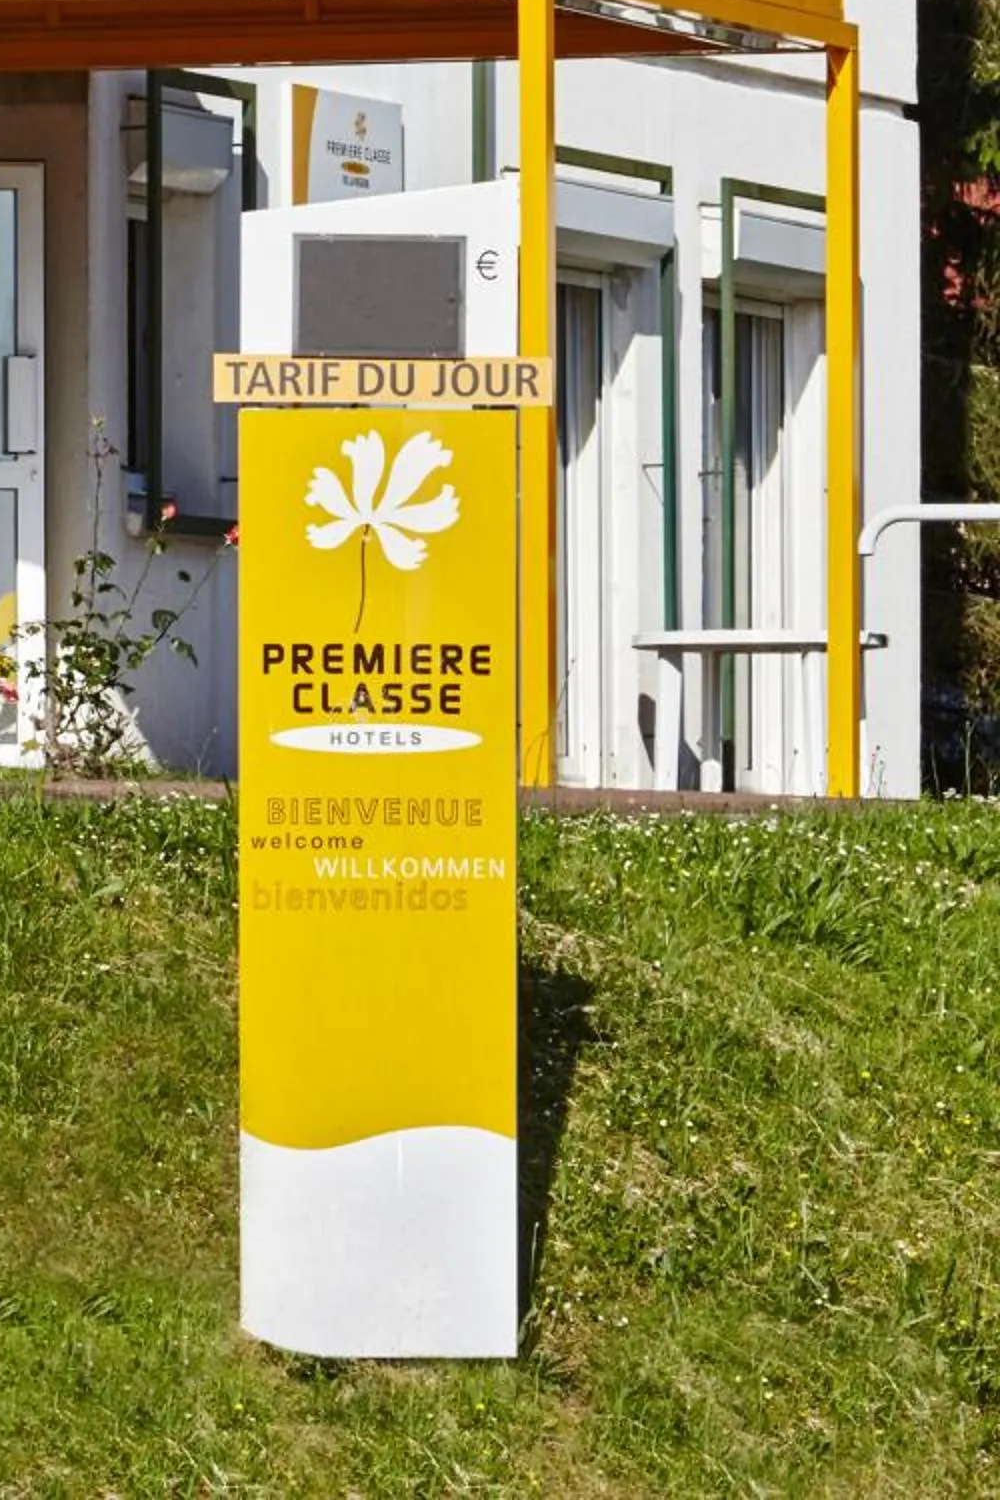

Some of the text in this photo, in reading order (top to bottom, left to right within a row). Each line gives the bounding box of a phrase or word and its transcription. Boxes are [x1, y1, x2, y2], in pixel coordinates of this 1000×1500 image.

[226, 361, 539, 398] TARIF DU JOUR
[263, 643, 492, 675] PREMIERE
[292, 682, 461, 715] CLASSE
[329, 731, 422, 746] HOTELS
[267, 797, 483, 827] BIENVENUE
[251, 833, 365, 850] welcome
[313, 857, 506, 879] WILLKOMMEN
[252, 880, 468, 912] bienvenidos
